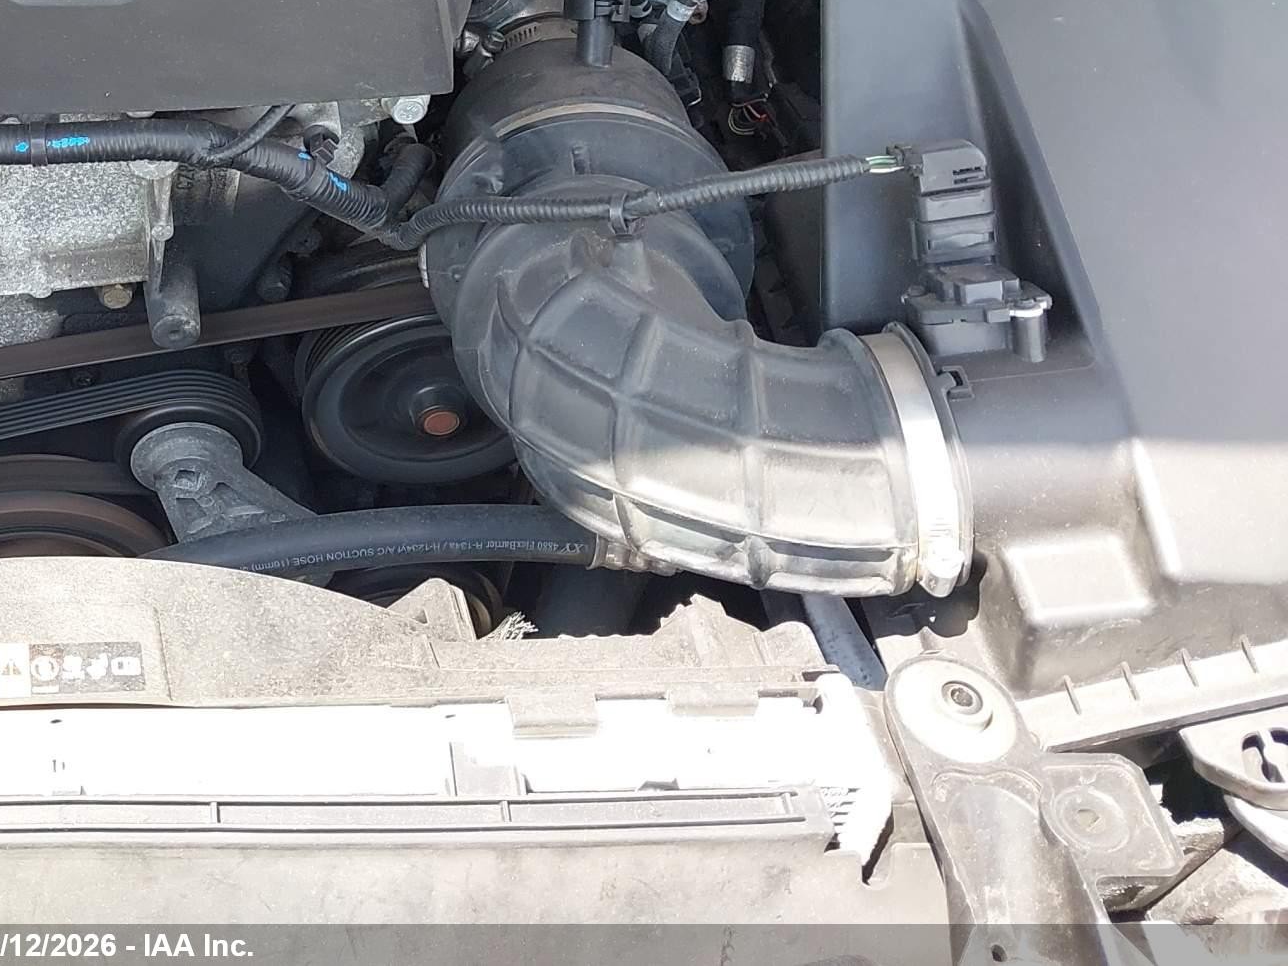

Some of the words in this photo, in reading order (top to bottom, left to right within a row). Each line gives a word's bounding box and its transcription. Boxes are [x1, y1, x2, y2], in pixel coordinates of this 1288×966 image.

[376, 543, 396, 555] A/C
[485, 540, 535, 552] FlexBarrier
[293, 554, 324, 566] HOSE
[326, 546, 375, 563] SUCTION
